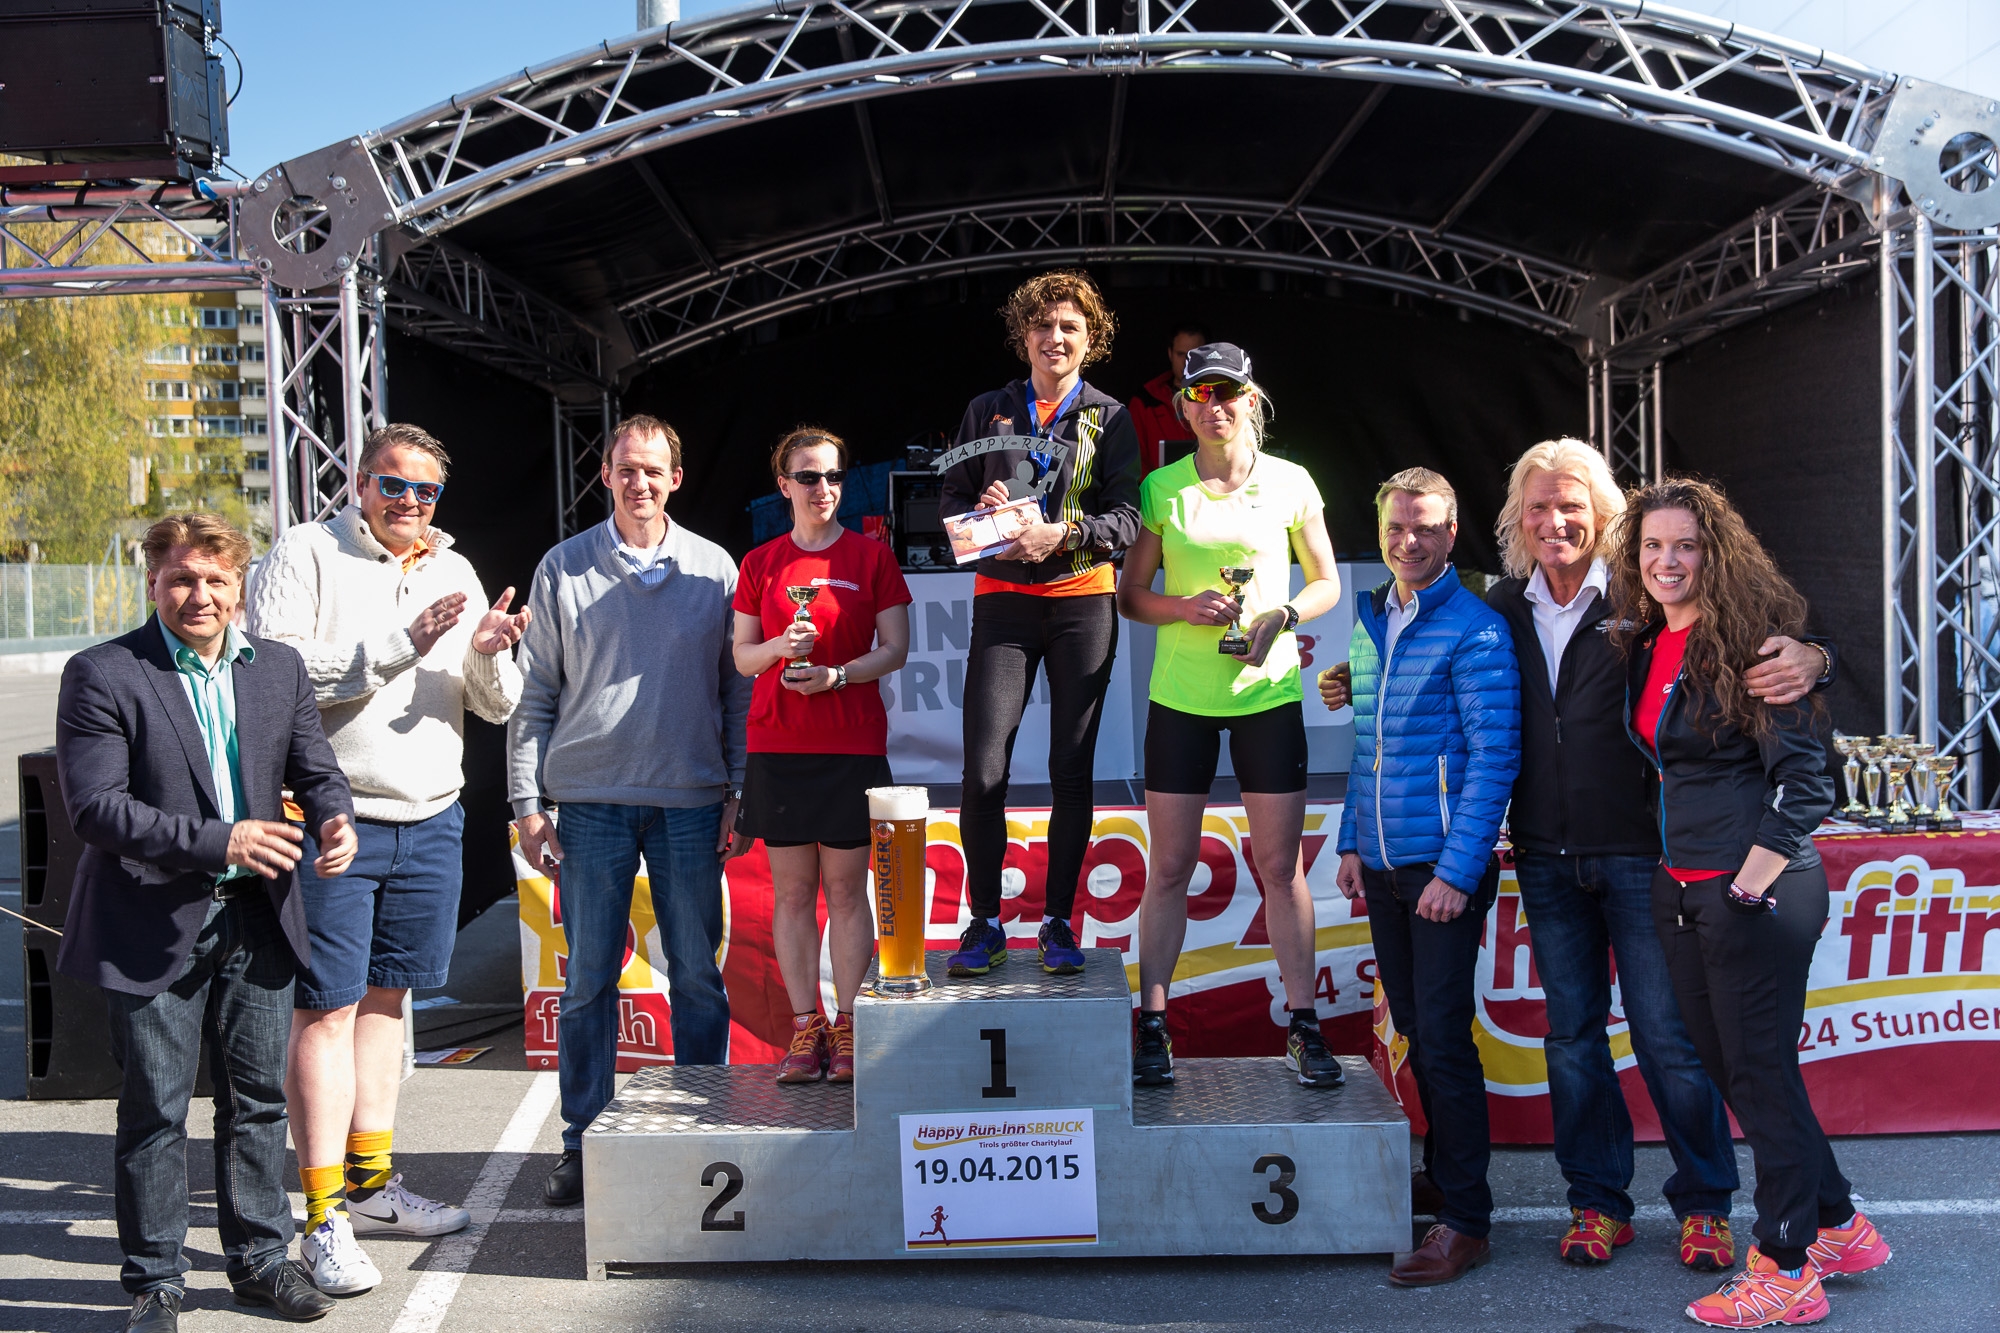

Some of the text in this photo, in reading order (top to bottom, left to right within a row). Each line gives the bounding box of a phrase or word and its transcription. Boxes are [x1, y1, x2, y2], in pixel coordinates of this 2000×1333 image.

[944, 436, 1064, 468] HAPPY-RUN
[876, 840, 895, 936] ERDINGER
[1797, 1000, 2000, 1051] 24 Stunde
[980, 1029, 1016, 1098] 1
[917, 1124, 964, 1142] Happy
[979, 1139, 1073, 1149] Tirols größter Charitylauf
[914, 1154, 1080, 1185] 19.04.2015
[1251, 1153, 1300, 1225] 3
[700, 1161, 746, 1232] 2
